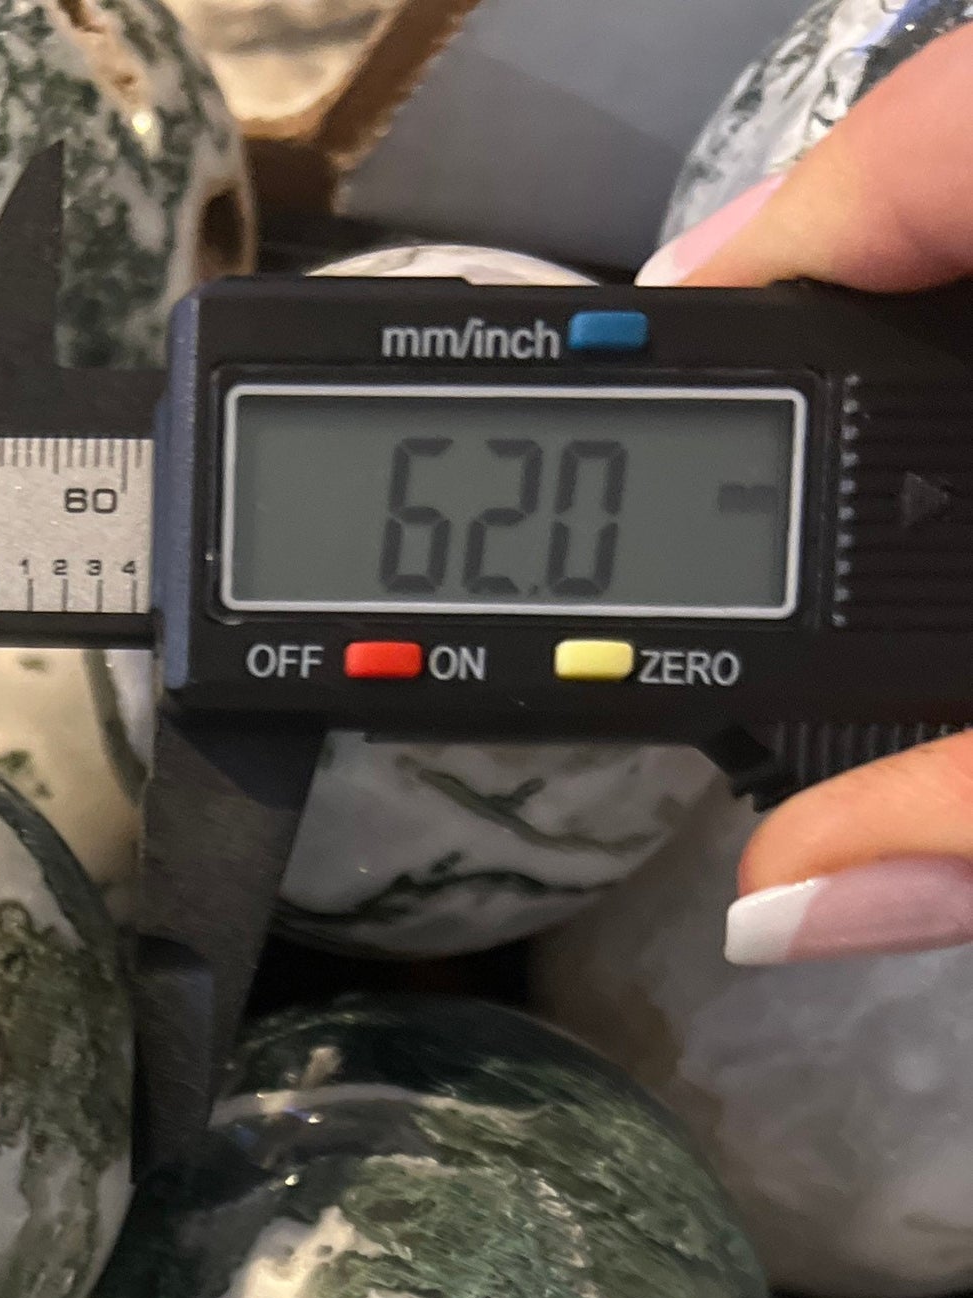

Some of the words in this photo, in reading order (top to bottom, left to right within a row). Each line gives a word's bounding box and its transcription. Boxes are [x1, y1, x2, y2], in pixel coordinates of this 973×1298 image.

[381, 317, 561, 360] mm/inch
[63, 487, 119, 515] 60
[377, 436, 627, 597] 62.0
[18, 558, 30, 575] 1
[51, 558, 69, 576] 2
[85, 558, 103, 576] 3
[120, 559, 137, 576] 4
[245, 643, 325, 679] OFF
[428, 645, 487, 681] ON
[638, 649, 741, 687] ZERO
